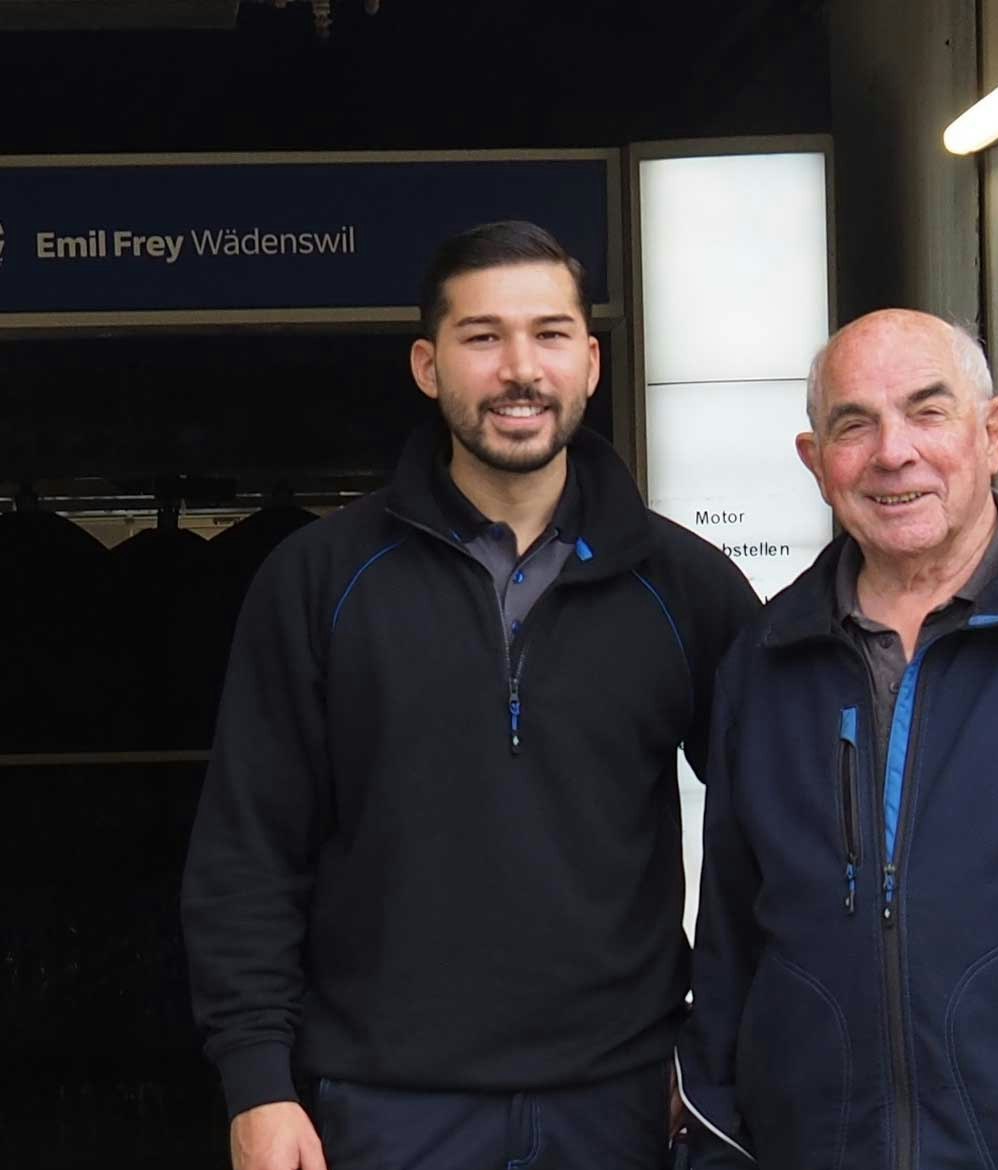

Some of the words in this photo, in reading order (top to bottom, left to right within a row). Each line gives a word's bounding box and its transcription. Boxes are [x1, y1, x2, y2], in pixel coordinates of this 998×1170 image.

[36, 230, 106, 258] Emil
[113, 231, 184, 263] Frey
[190, 226, 355, 256] Wädenswil
[695, 510, 745, 525] Motor
[721, 541, 790, 558] bstellen
